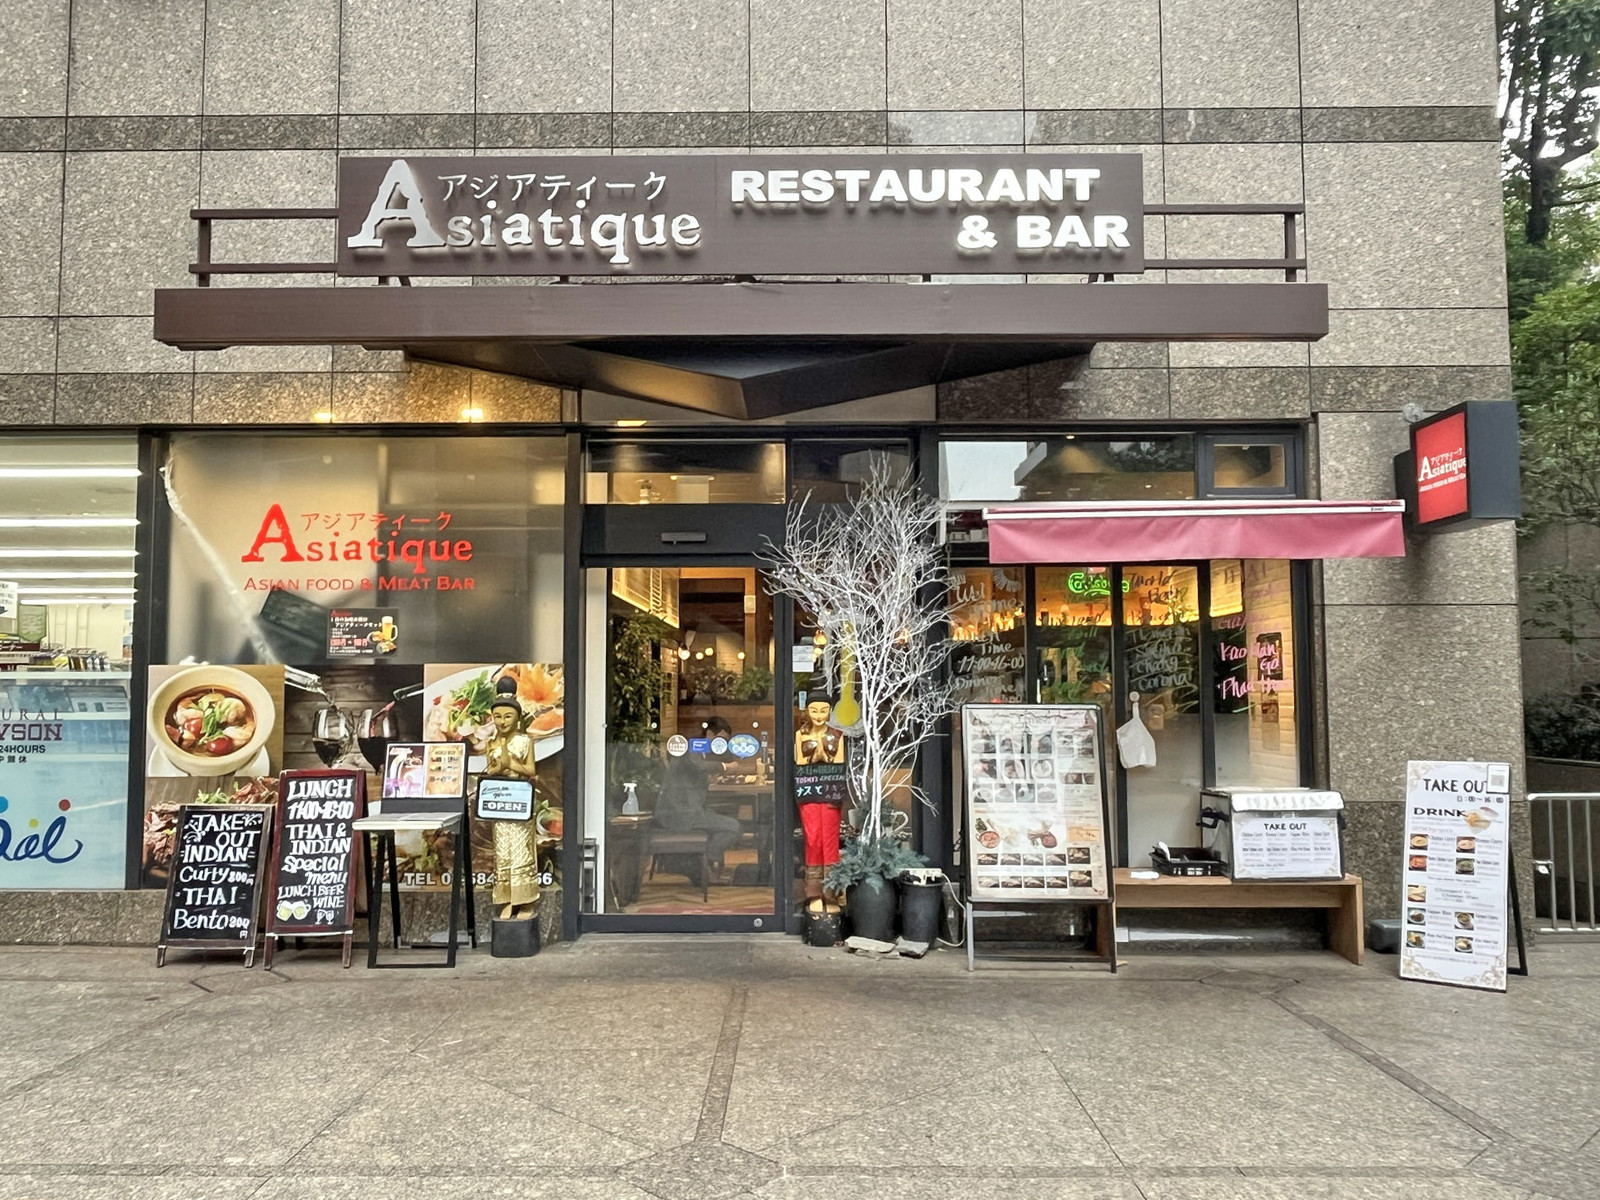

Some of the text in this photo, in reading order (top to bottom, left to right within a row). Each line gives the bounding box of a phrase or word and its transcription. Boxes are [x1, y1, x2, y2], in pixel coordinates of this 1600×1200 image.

[437, 171, 667, 201] アジアティーク
[731, 168, 1101, 203] RESTAURANT
[347, 159, 701, 264] Asiatique
[956, 214, 1131, 250] & BAR
[1418, 456, 1466, 482] Asiatique
[300, 510, 453, 532] アジアティーク
[241, 503, 473, 575] Asiatique
[243, 576, 475, 592] ASIAN FOOD & MEAT BAR
[287, 778, 354, 801] LUNCH
[1423, 777, 1488, 794] TAKE OU
[486, 801, 523, 812] OPEN
[1413, 806, 1469, 818] DRINK
[192, 813, 244, 832] TAKE
[285, 822, 347, 840] THAI &
[1264, 822, 1307, 831] TAKE OUT
[215, 830, 261, 849] OUT
[289, 837, 352, 856] INDIAN
[281, 854, 346, 873] Special
[179, 865, 230, 885] Curry
[305, 871, 348, 886] menu
[403, 872, 436, 886] TEL
[182, 885, 239, 906] THAI
[277, 884, 317, 901] LUNCH
[312, 895, 345, 909] WINE
[173, 908, 229, 930] Bento
